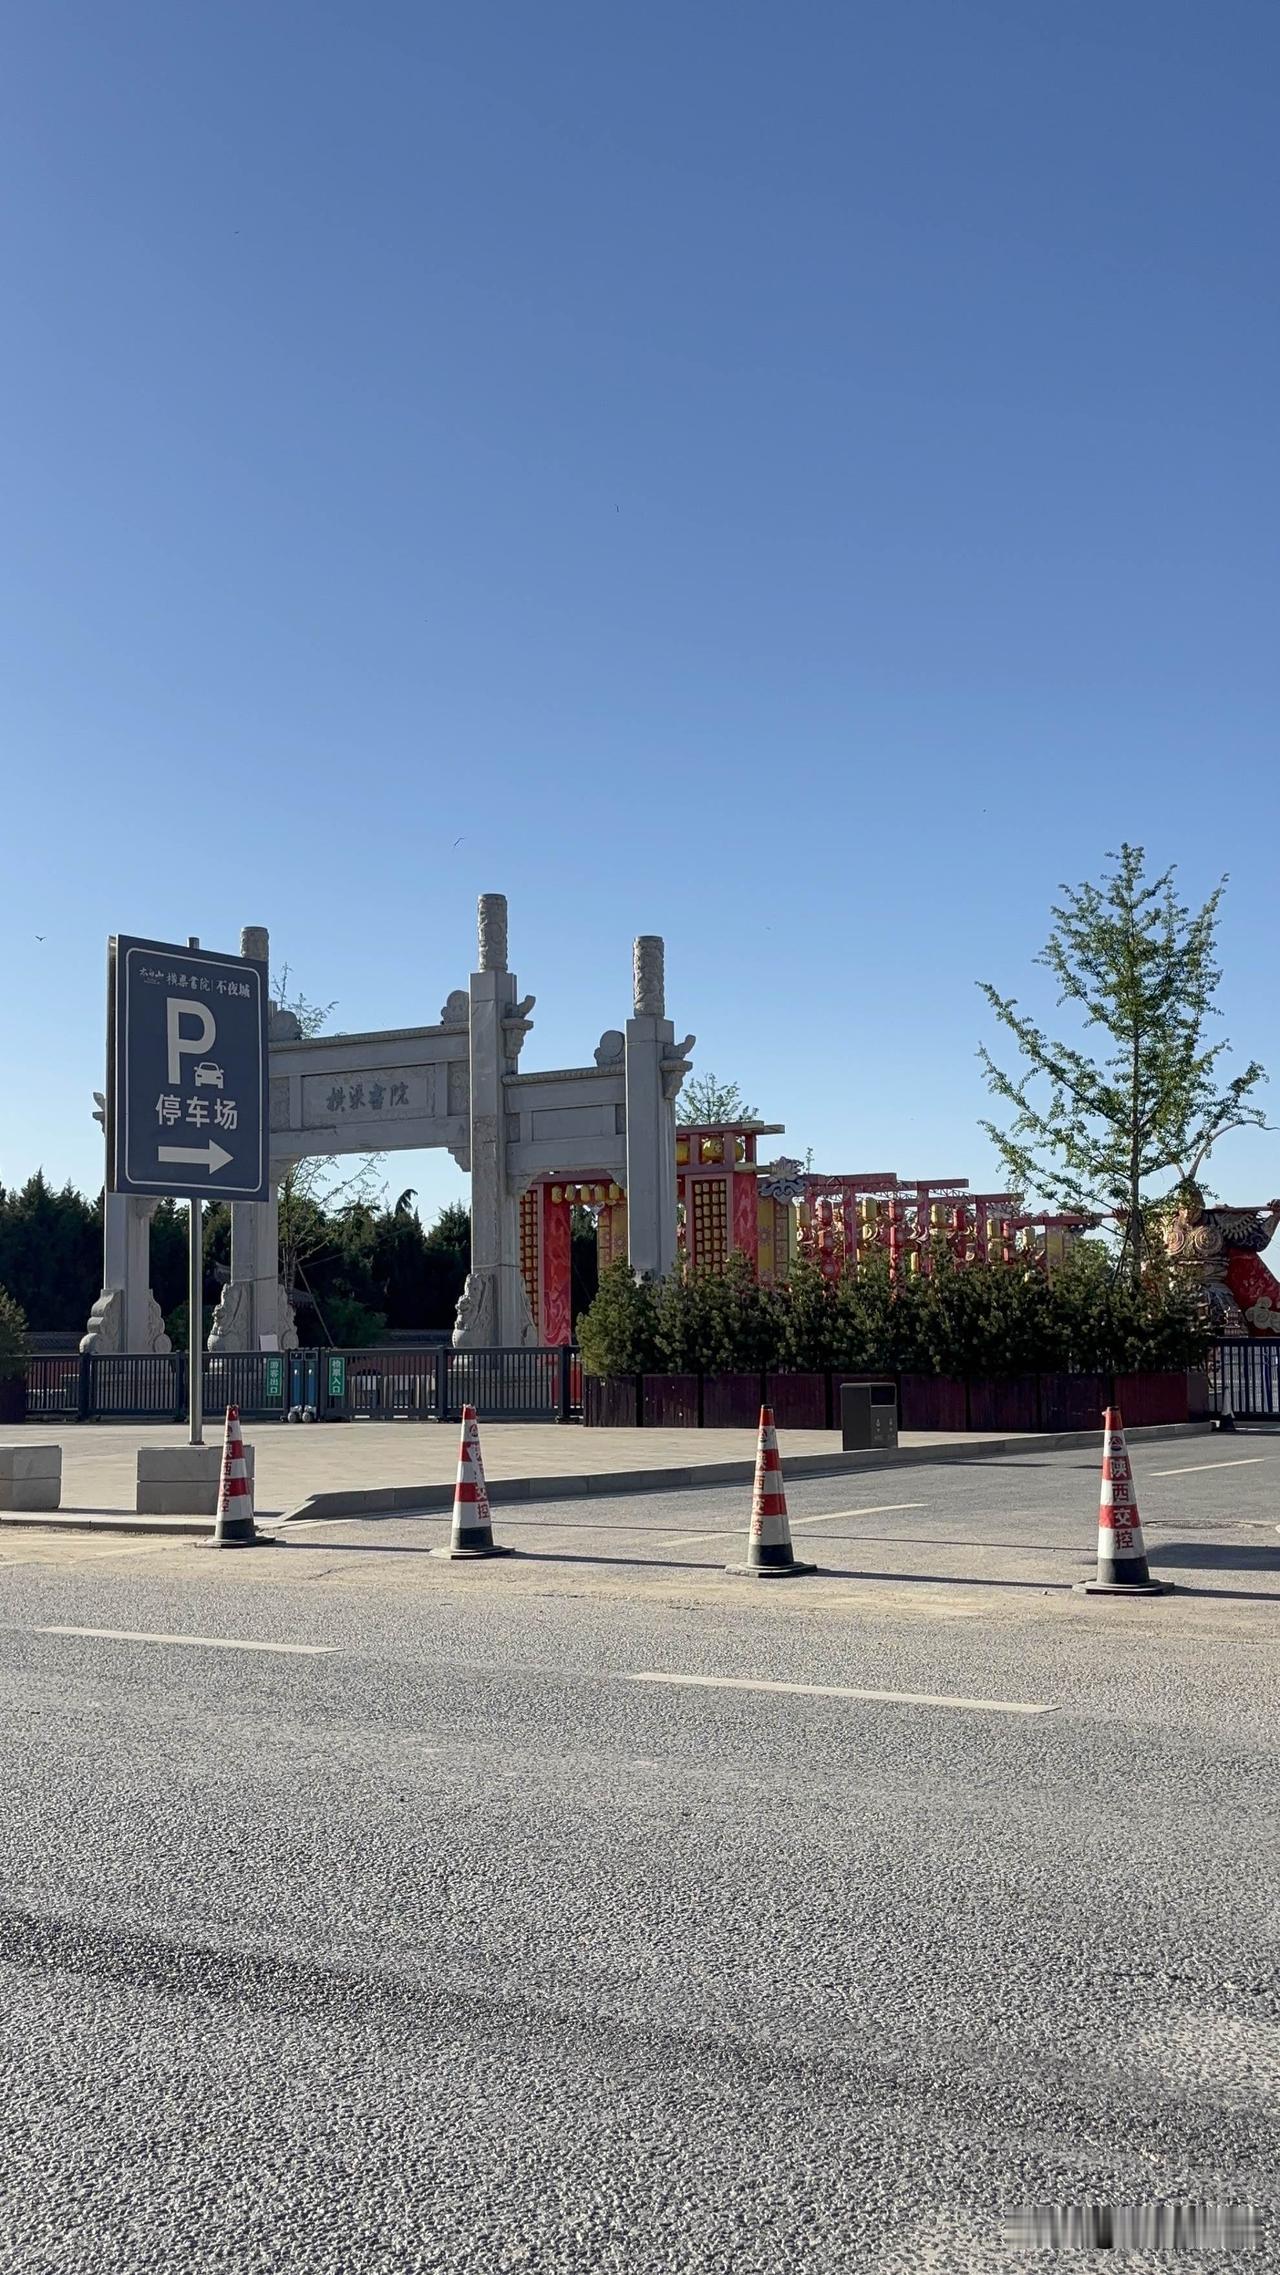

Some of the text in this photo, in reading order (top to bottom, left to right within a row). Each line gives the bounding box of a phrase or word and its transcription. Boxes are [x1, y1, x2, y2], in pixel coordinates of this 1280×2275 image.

[166, 997, 216, 1085] P
[155, 1093, 239, 1130] 停车场
[1110, 1458, 1134, 1550] 陕西交控
